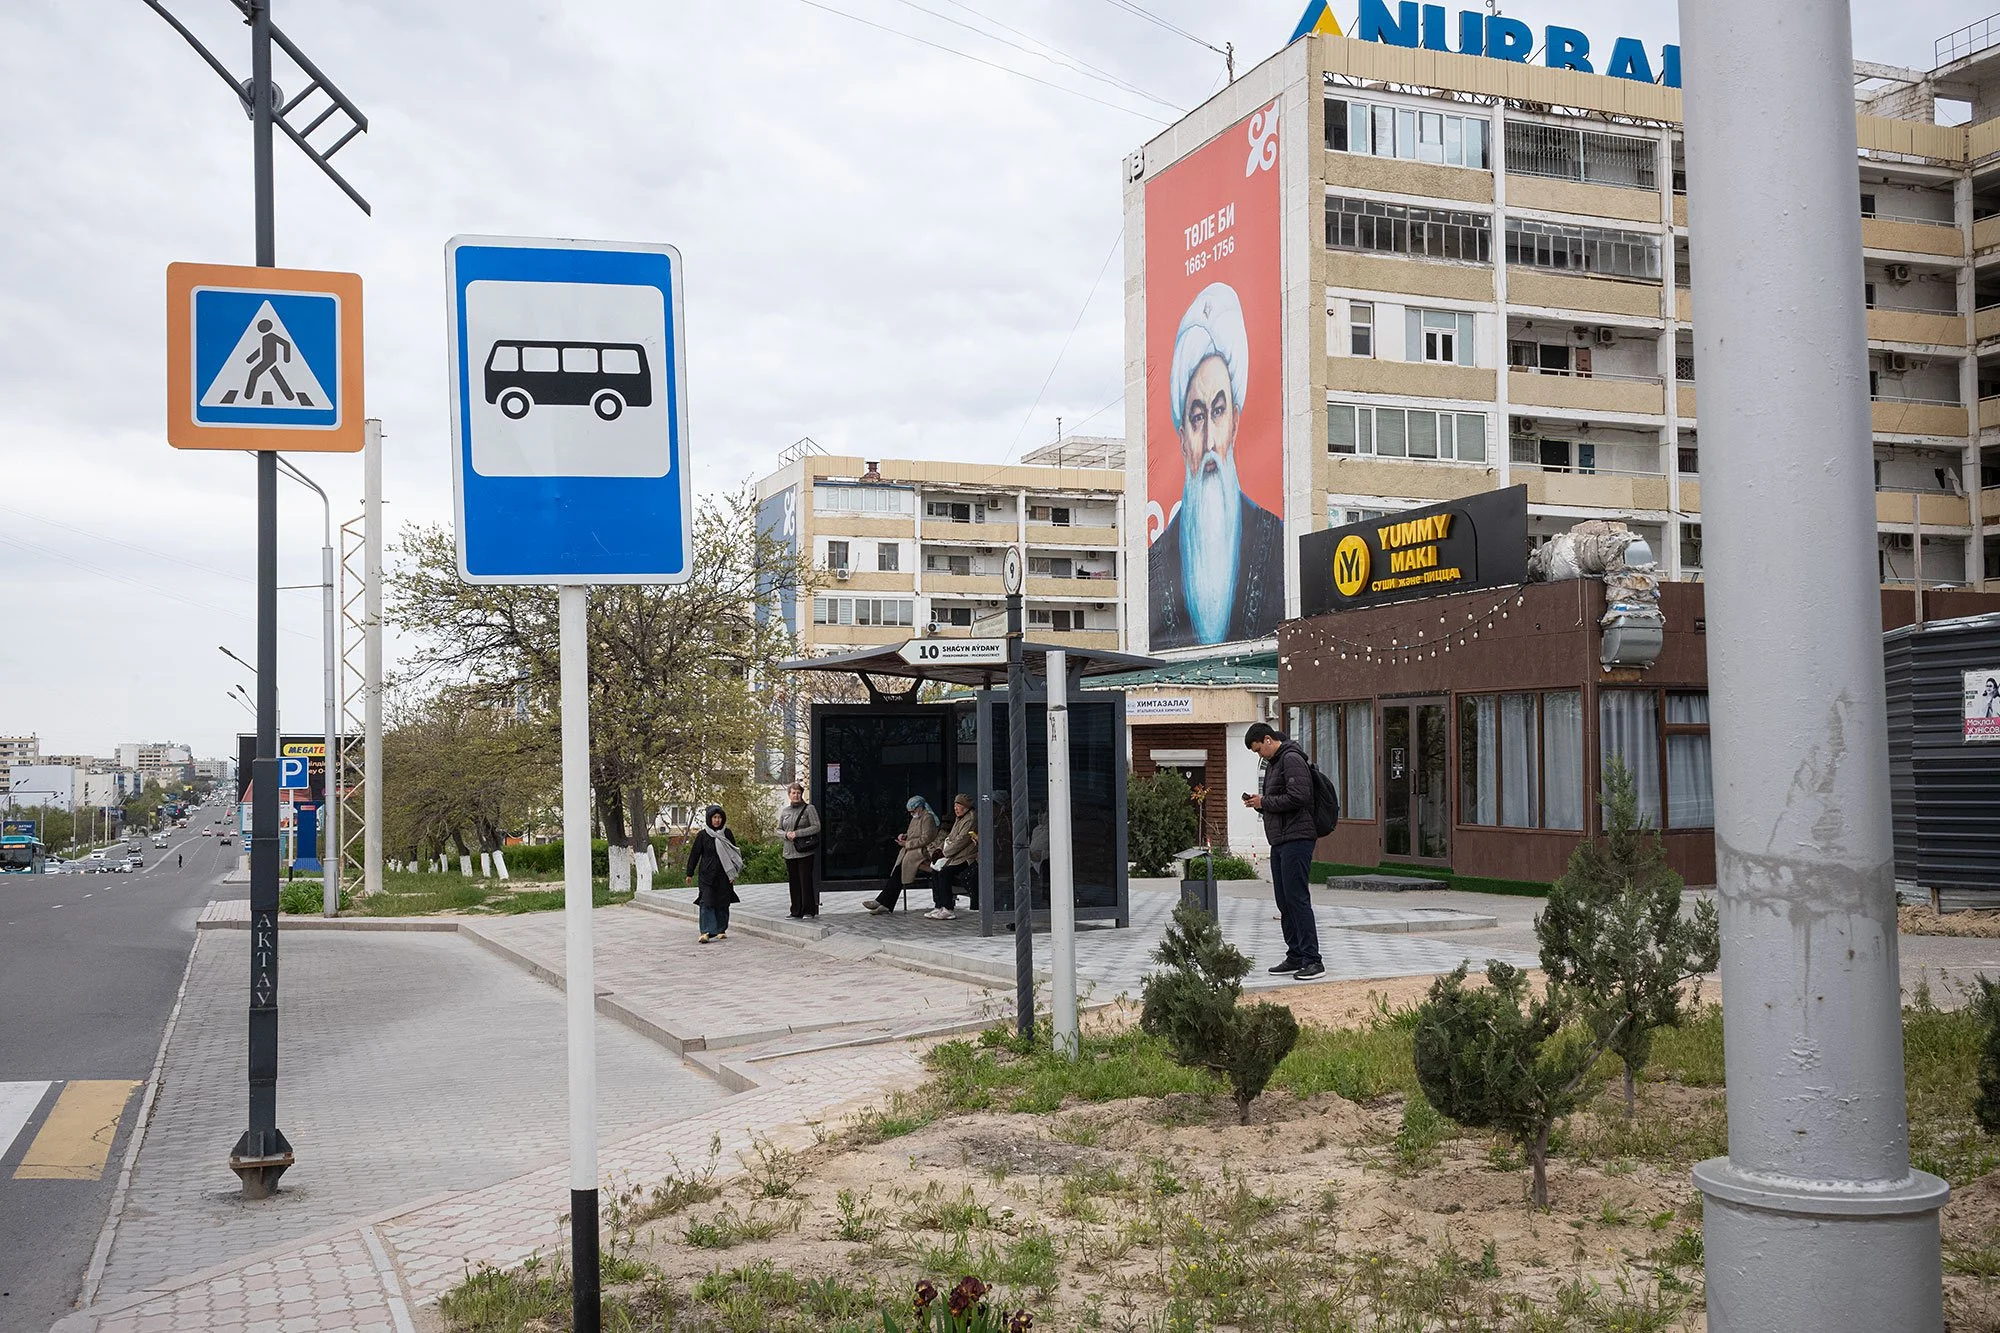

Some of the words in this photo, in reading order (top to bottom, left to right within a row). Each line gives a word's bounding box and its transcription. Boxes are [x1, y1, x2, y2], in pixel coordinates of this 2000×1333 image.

[1184, 213, 1216, 251] ТӨЛЕ
[1217, 202, 1235, 234] БИ
[1377, 513, 1453, 551] YUMMY
[1390, 545, 1438, 574] MAKI
[1371, 573, 1397, 592] СУШИ
[1398, 574, 1422, 588] және
[1423, 567, 1462, 585] ПИЦЦА
[919, 645, 940, 660] 10
[1136, 699, 1189, 708] ХИМТАЗАЛАУ
[281, 759, 303, 787] P
